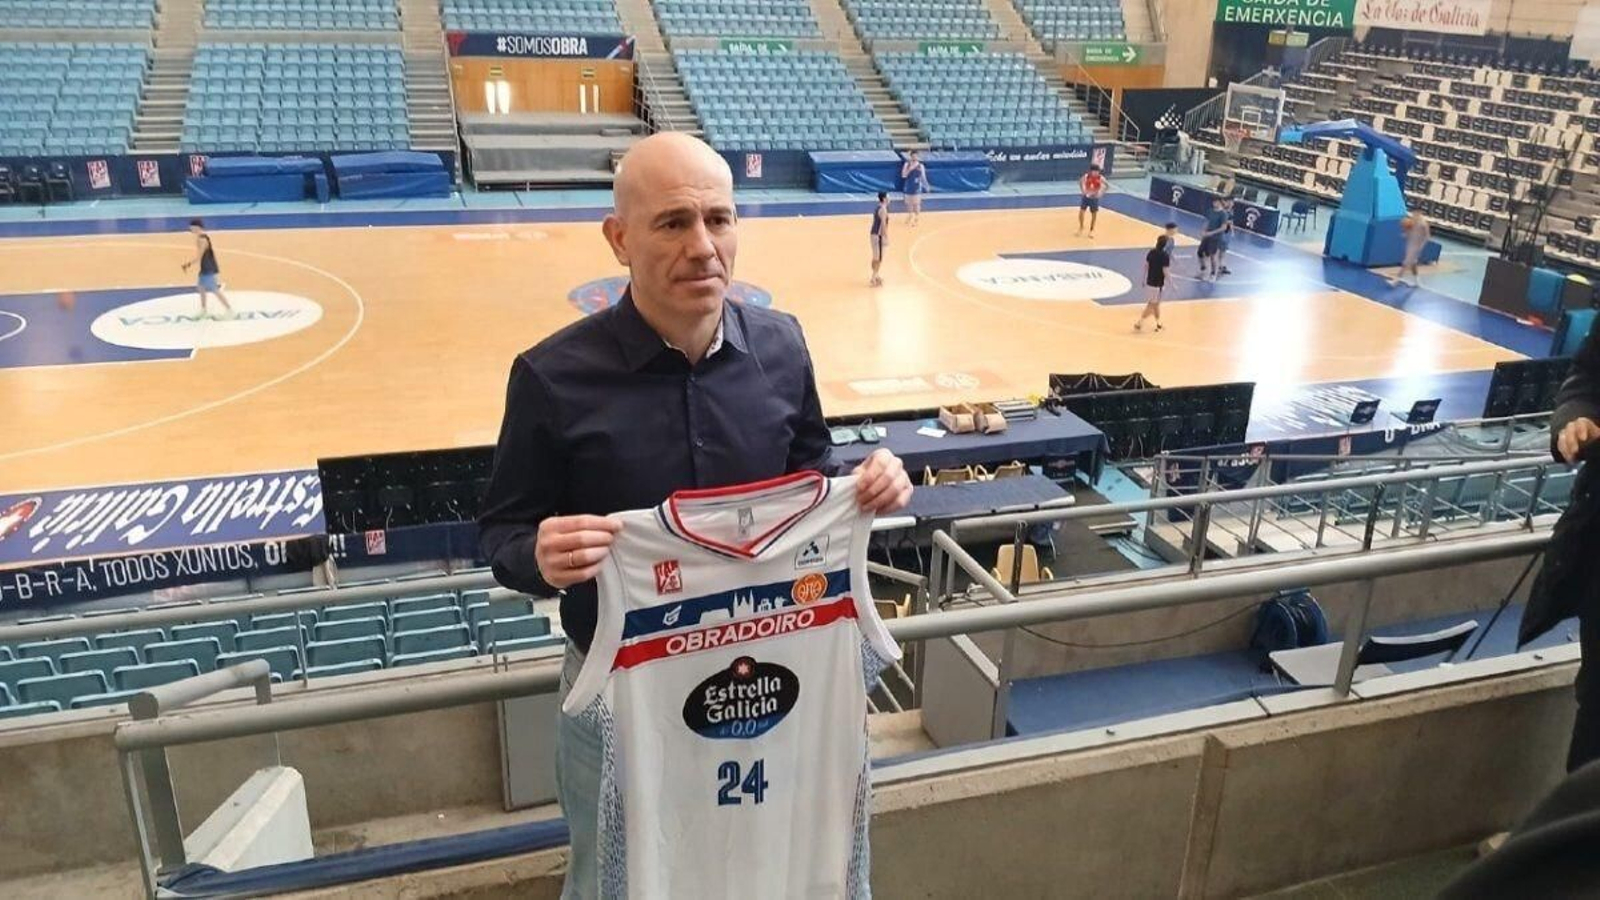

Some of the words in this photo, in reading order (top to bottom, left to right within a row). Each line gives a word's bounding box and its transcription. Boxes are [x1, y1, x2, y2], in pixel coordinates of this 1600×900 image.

[1224, 6, 1344, 27] EMERXENCIA
[497, 36, 588, 55] #SOMOSOBRA
[29, 484, 189, 553] Galicia
[181, 474, 323, 536] Estrella
[99, 552, 170, 588] TODOS
[172, 544, 259, 577] XUNTOS,
[666, 610, 815, 655] OBRADOIRO
[703, 676, 782, 706] Estrella
[706, 696, 777, 723] Galicia
[718, 758, 769, 807] 24
